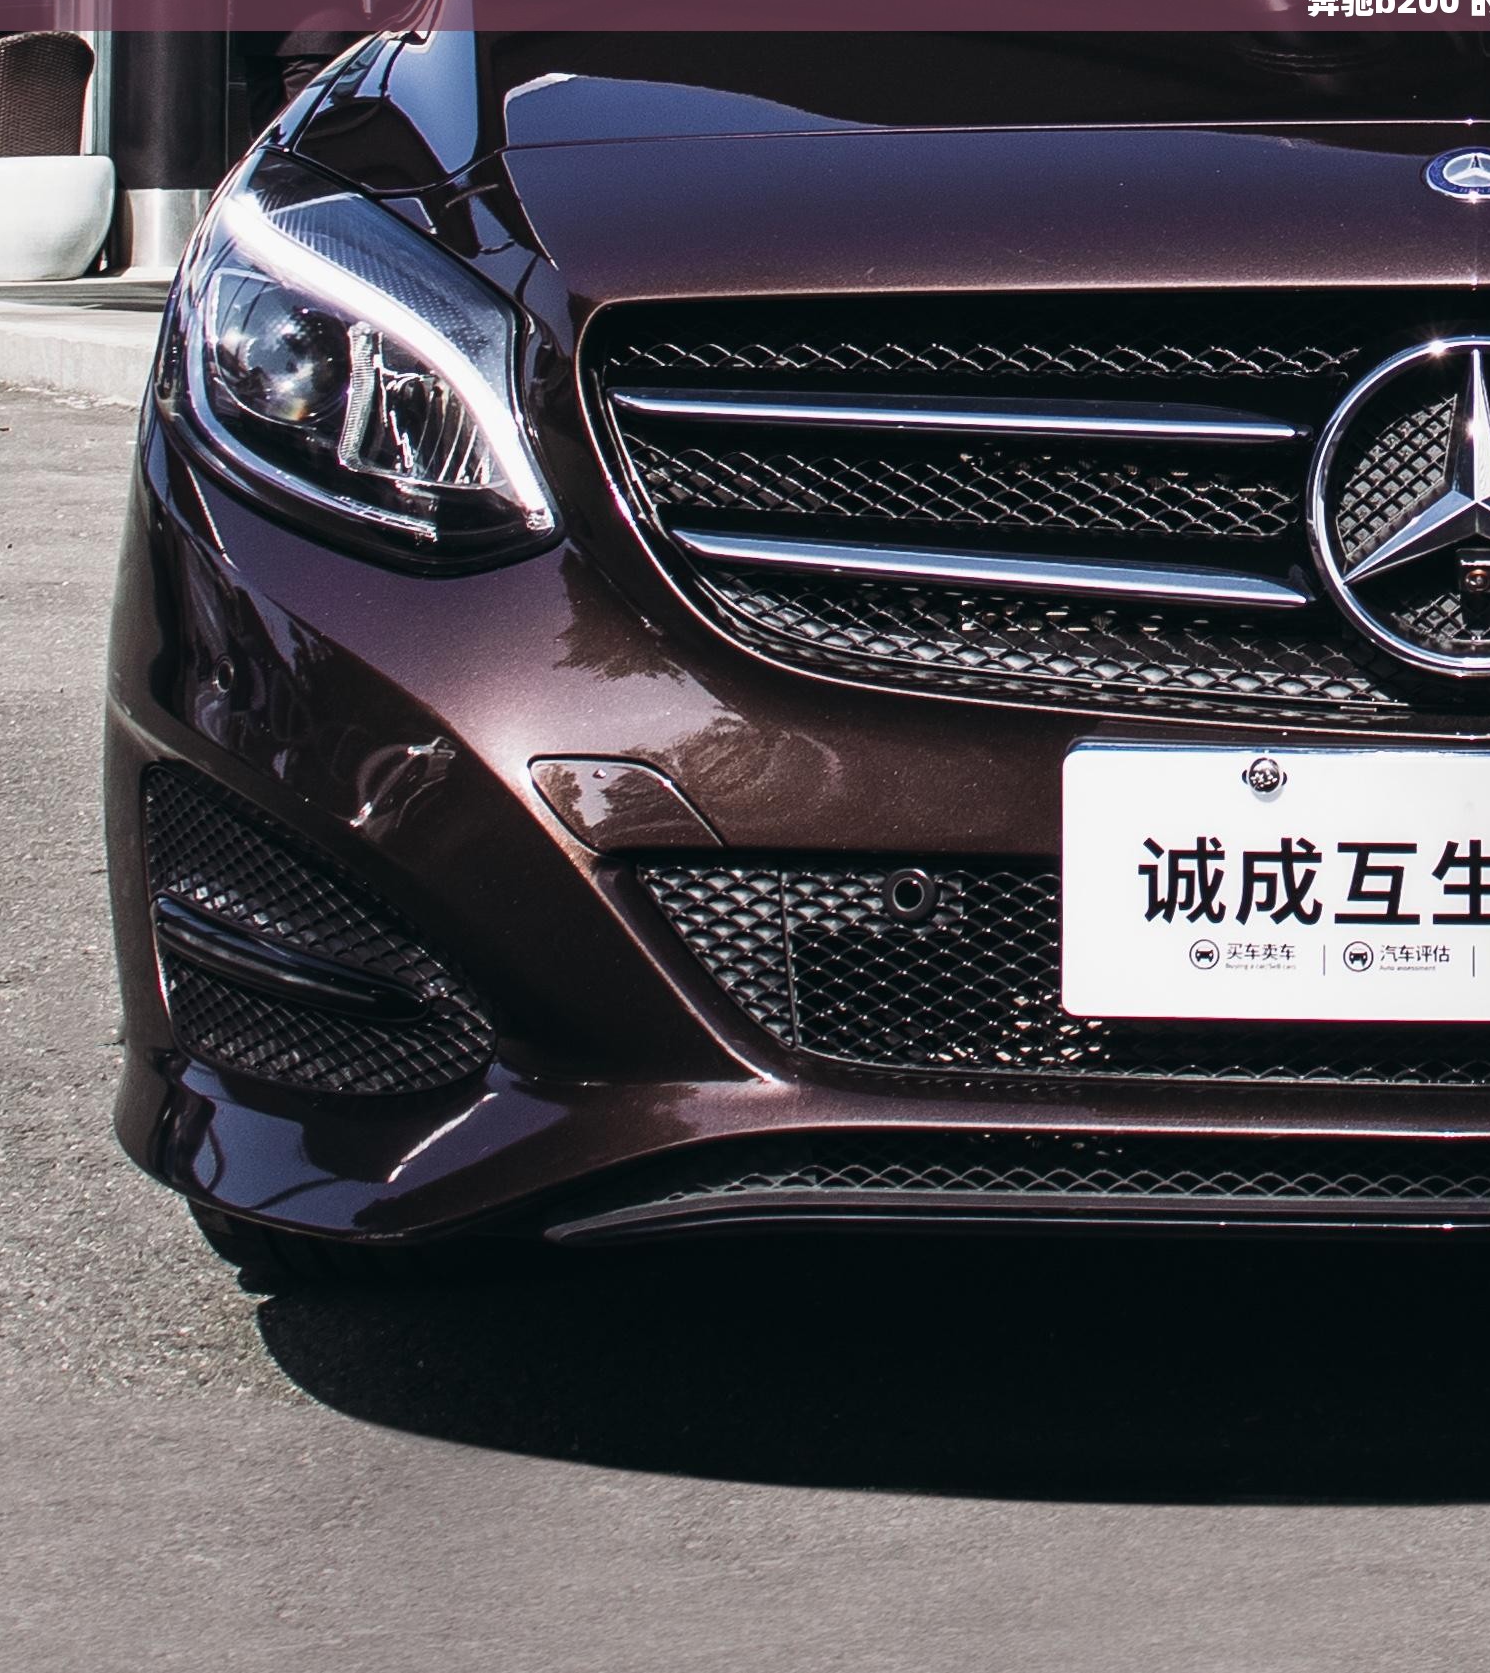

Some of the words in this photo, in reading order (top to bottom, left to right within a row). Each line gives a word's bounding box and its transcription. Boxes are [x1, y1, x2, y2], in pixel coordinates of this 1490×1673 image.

[1226, 942, 1296, 961] 买车卖车
[1379, 944, 1451, 963] 汽车评估
